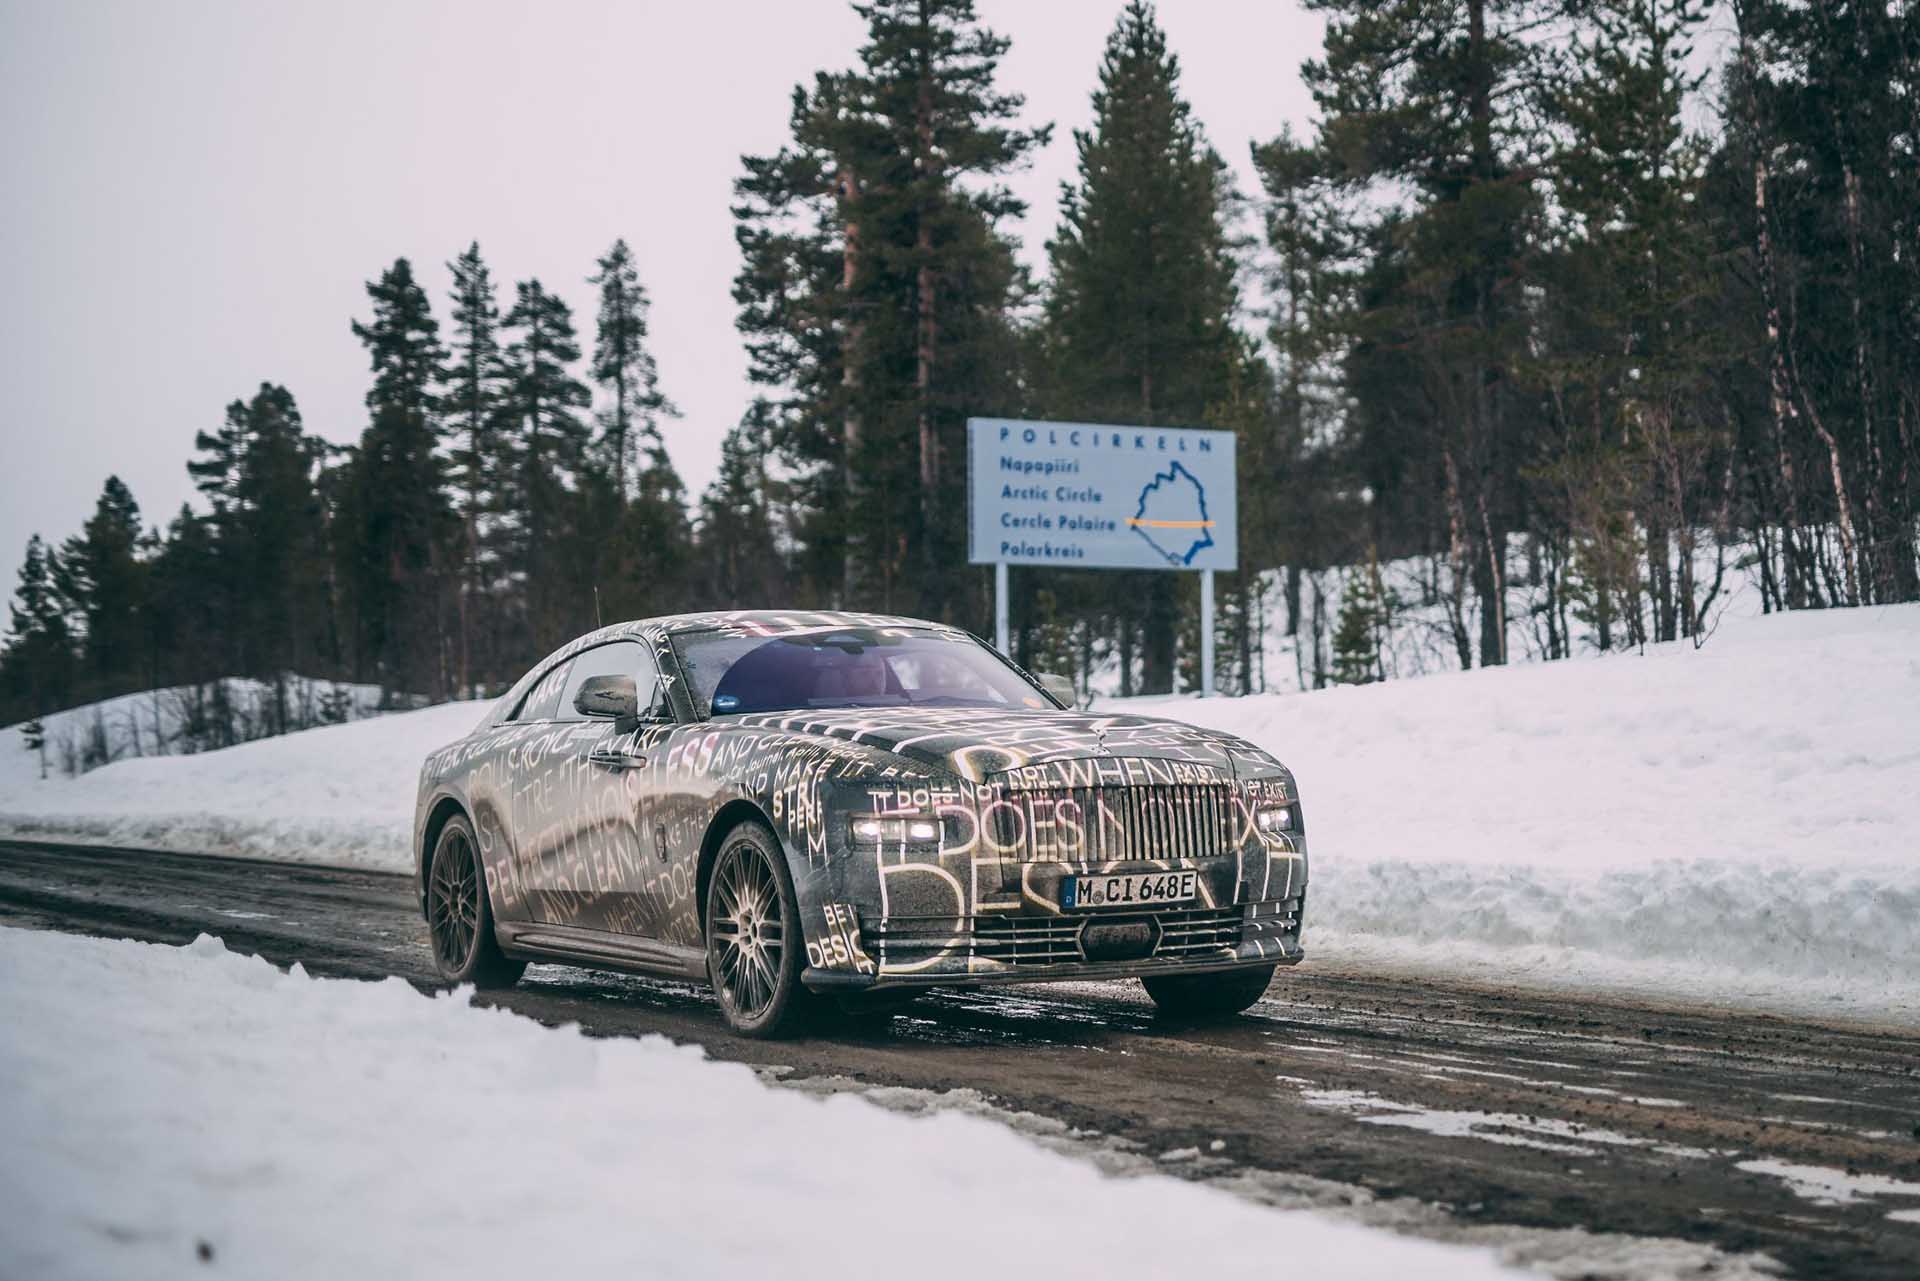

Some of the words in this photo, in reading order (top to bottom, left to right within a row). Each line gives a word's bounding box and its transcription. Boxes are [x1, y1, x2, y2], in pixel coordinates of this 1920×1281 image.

[1000, 426, 1212, 452] POLCIRKELN
[1000, 456, 1080, 475] Napapiiri
[1001, 484, 1051, 501] Arctic
[1056, 487, 1103, 502] Circle
[1001, 513, 1051, 529] Cercle
[1059, 514, 1116, 531] Polaire
[1001, 541, 1084, 559] Polarkreis
[1055, 757, 1178, 789] WHEN
[1139, 874, 1194, 901] 648E
